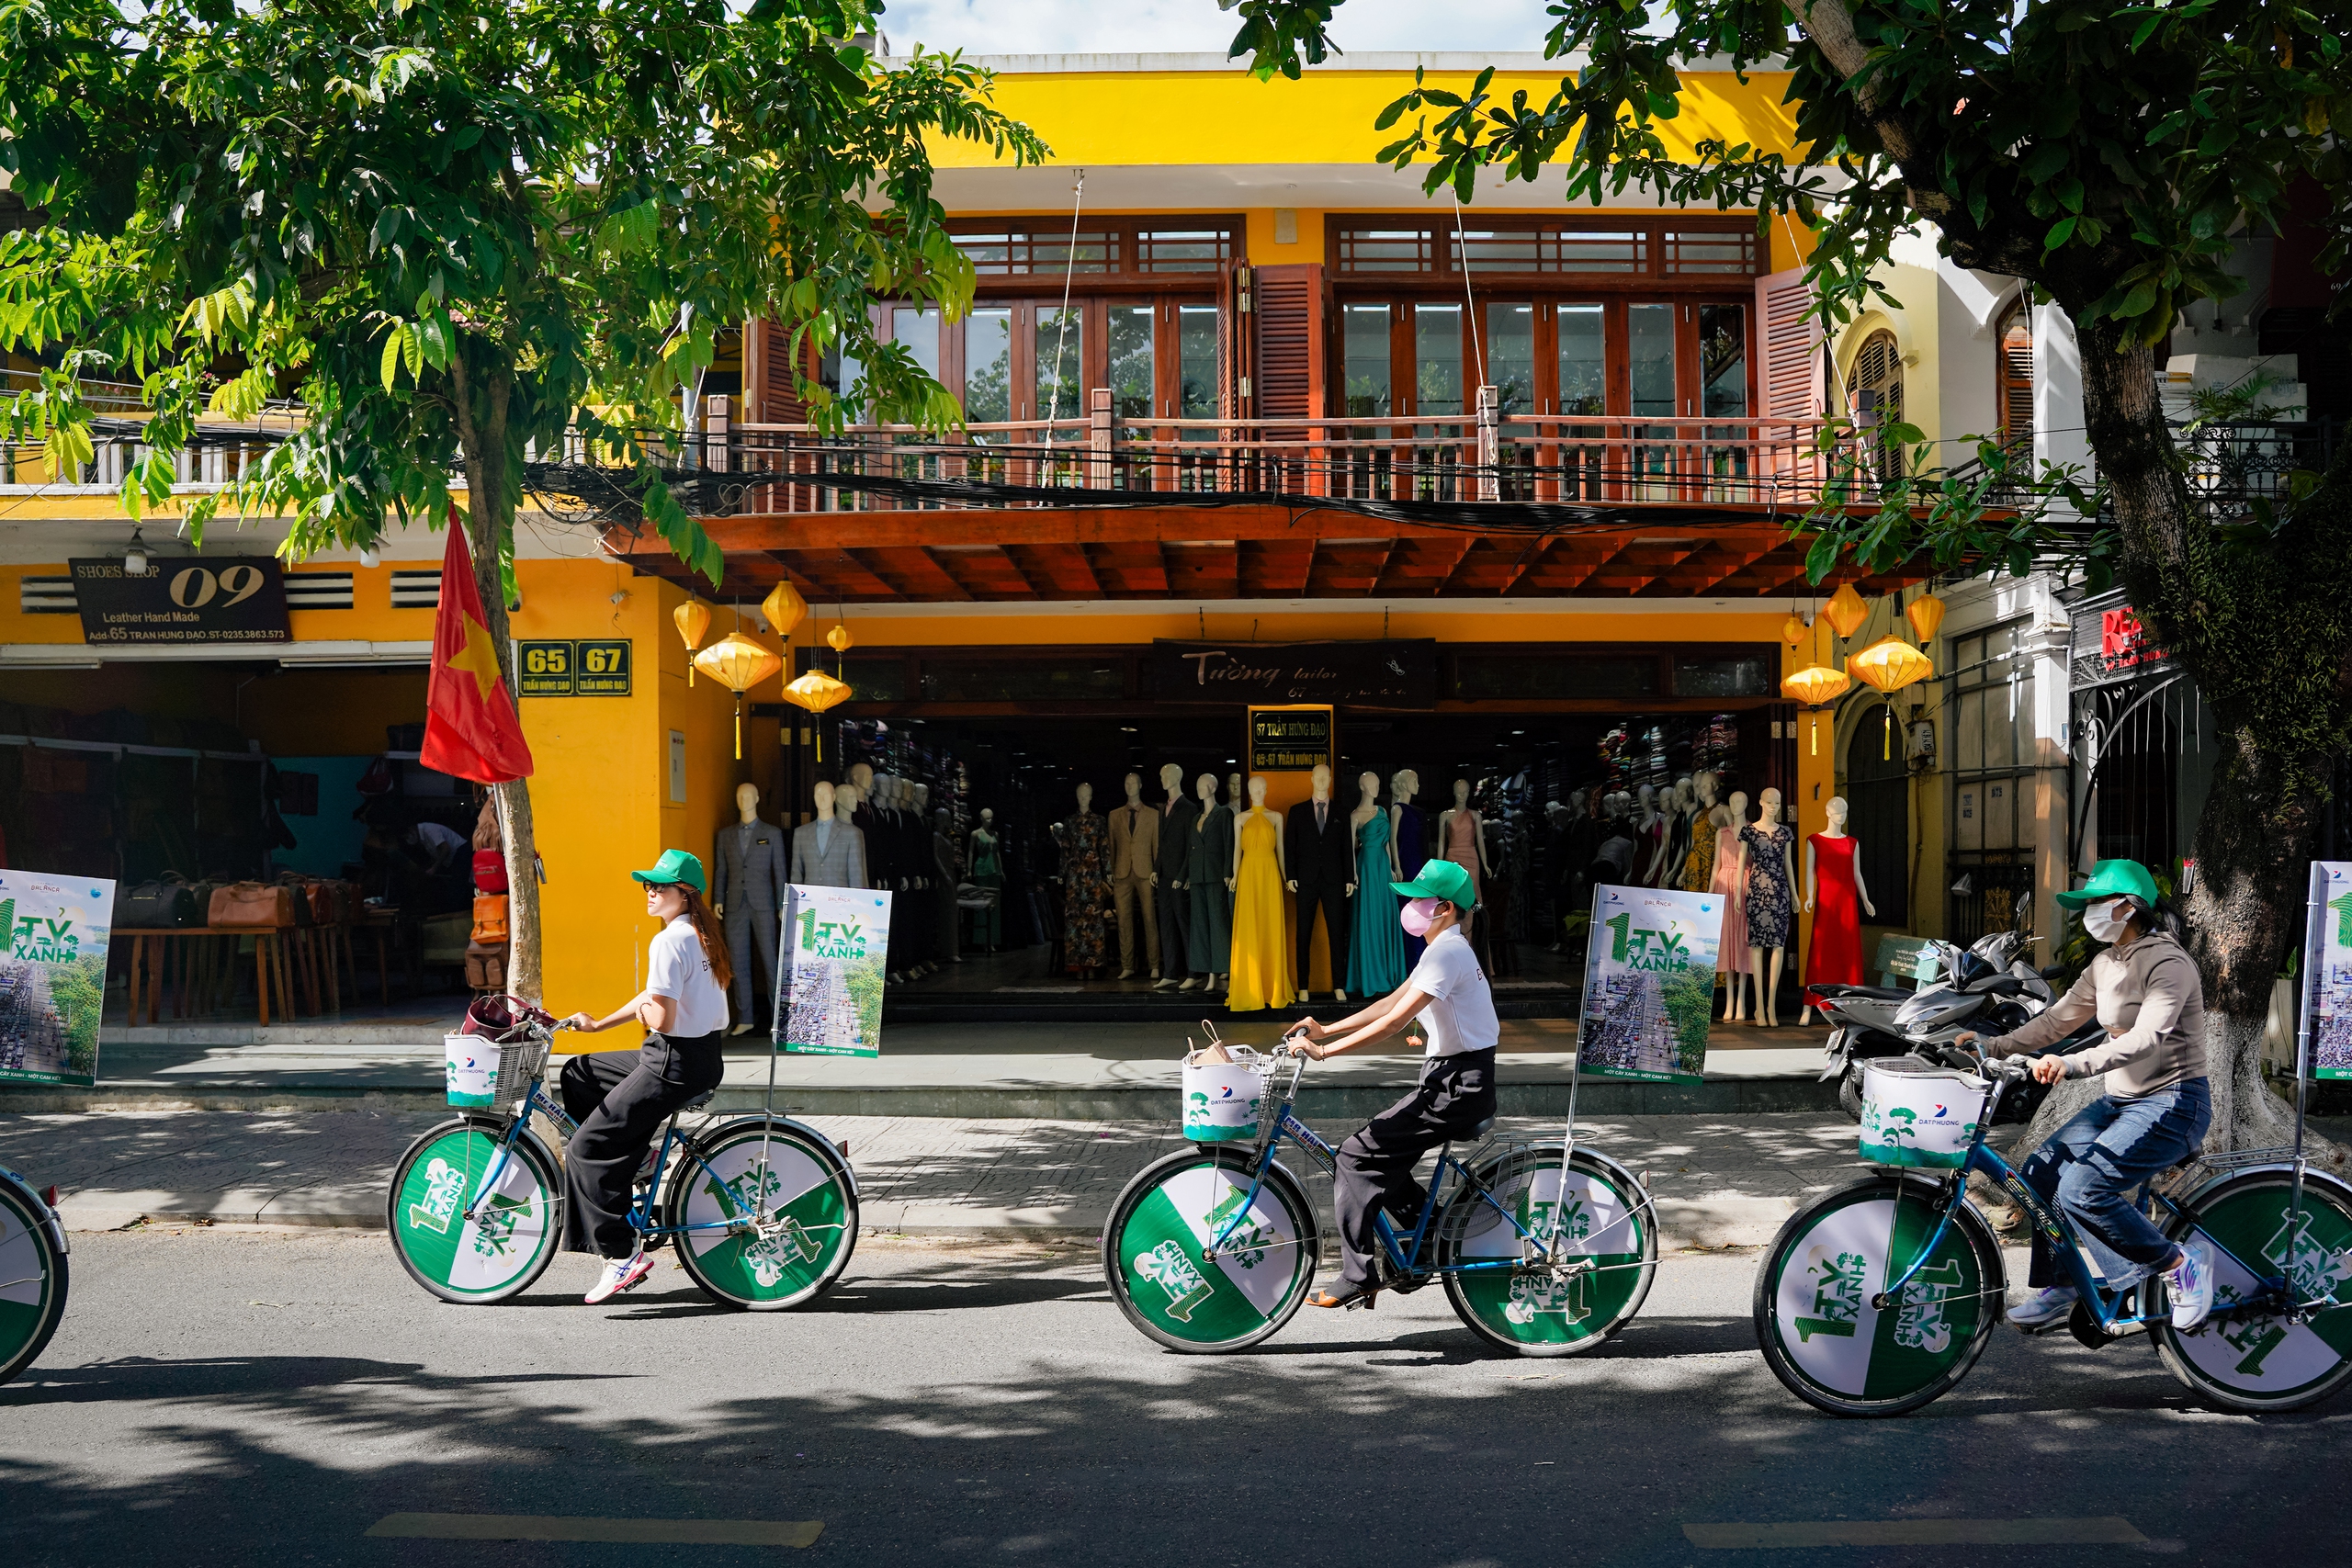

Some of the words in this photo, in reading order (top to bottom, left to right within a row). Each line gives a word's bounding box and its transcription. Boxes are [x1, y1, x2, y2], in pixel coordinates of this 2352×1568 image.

[77, 566, 122, 578] SHOES
[170, 565, 265, 608] 09
[103, 612, 142, 623] Leather
[144, 613, 171, 623] Hand
[173, 612, 199, 622] Made
[109, 627, 127, 640] 65
[129, 631, 157, 640] TRAN
[157, 631, 185, 640] HUNG
[527, 649, 566, 672] 65
[586, 649, 621, 671] 67
[1182, 650, 1283, 686] Tường
[1256, 723, 1265, 736] 67
[18, 907, 74, 948] TỶ
[796, 908, 817, 952] 1
[819, 914, 862, 943] TỶ
[1605, 912, 1631, 964] 1
[1633, 920, 1685, 956] TỶ
[14, 944, 77, 964] XANH
[816, 944, 865, 959] XANH
[1629, 954, 1690, 974] XANH
[440, 1172, 465, 1219] XANH
[412, 1206, 447, 1233] 1
[1164, 1240, 1203, 1287] XANH
[1842, 1254, 1867, 1319] XANH
[1168, 1283, 1213, 1321] 1
[1794, 1316, 1857, 1343] 1
[2234, 1325, 2288, 1377] 1
